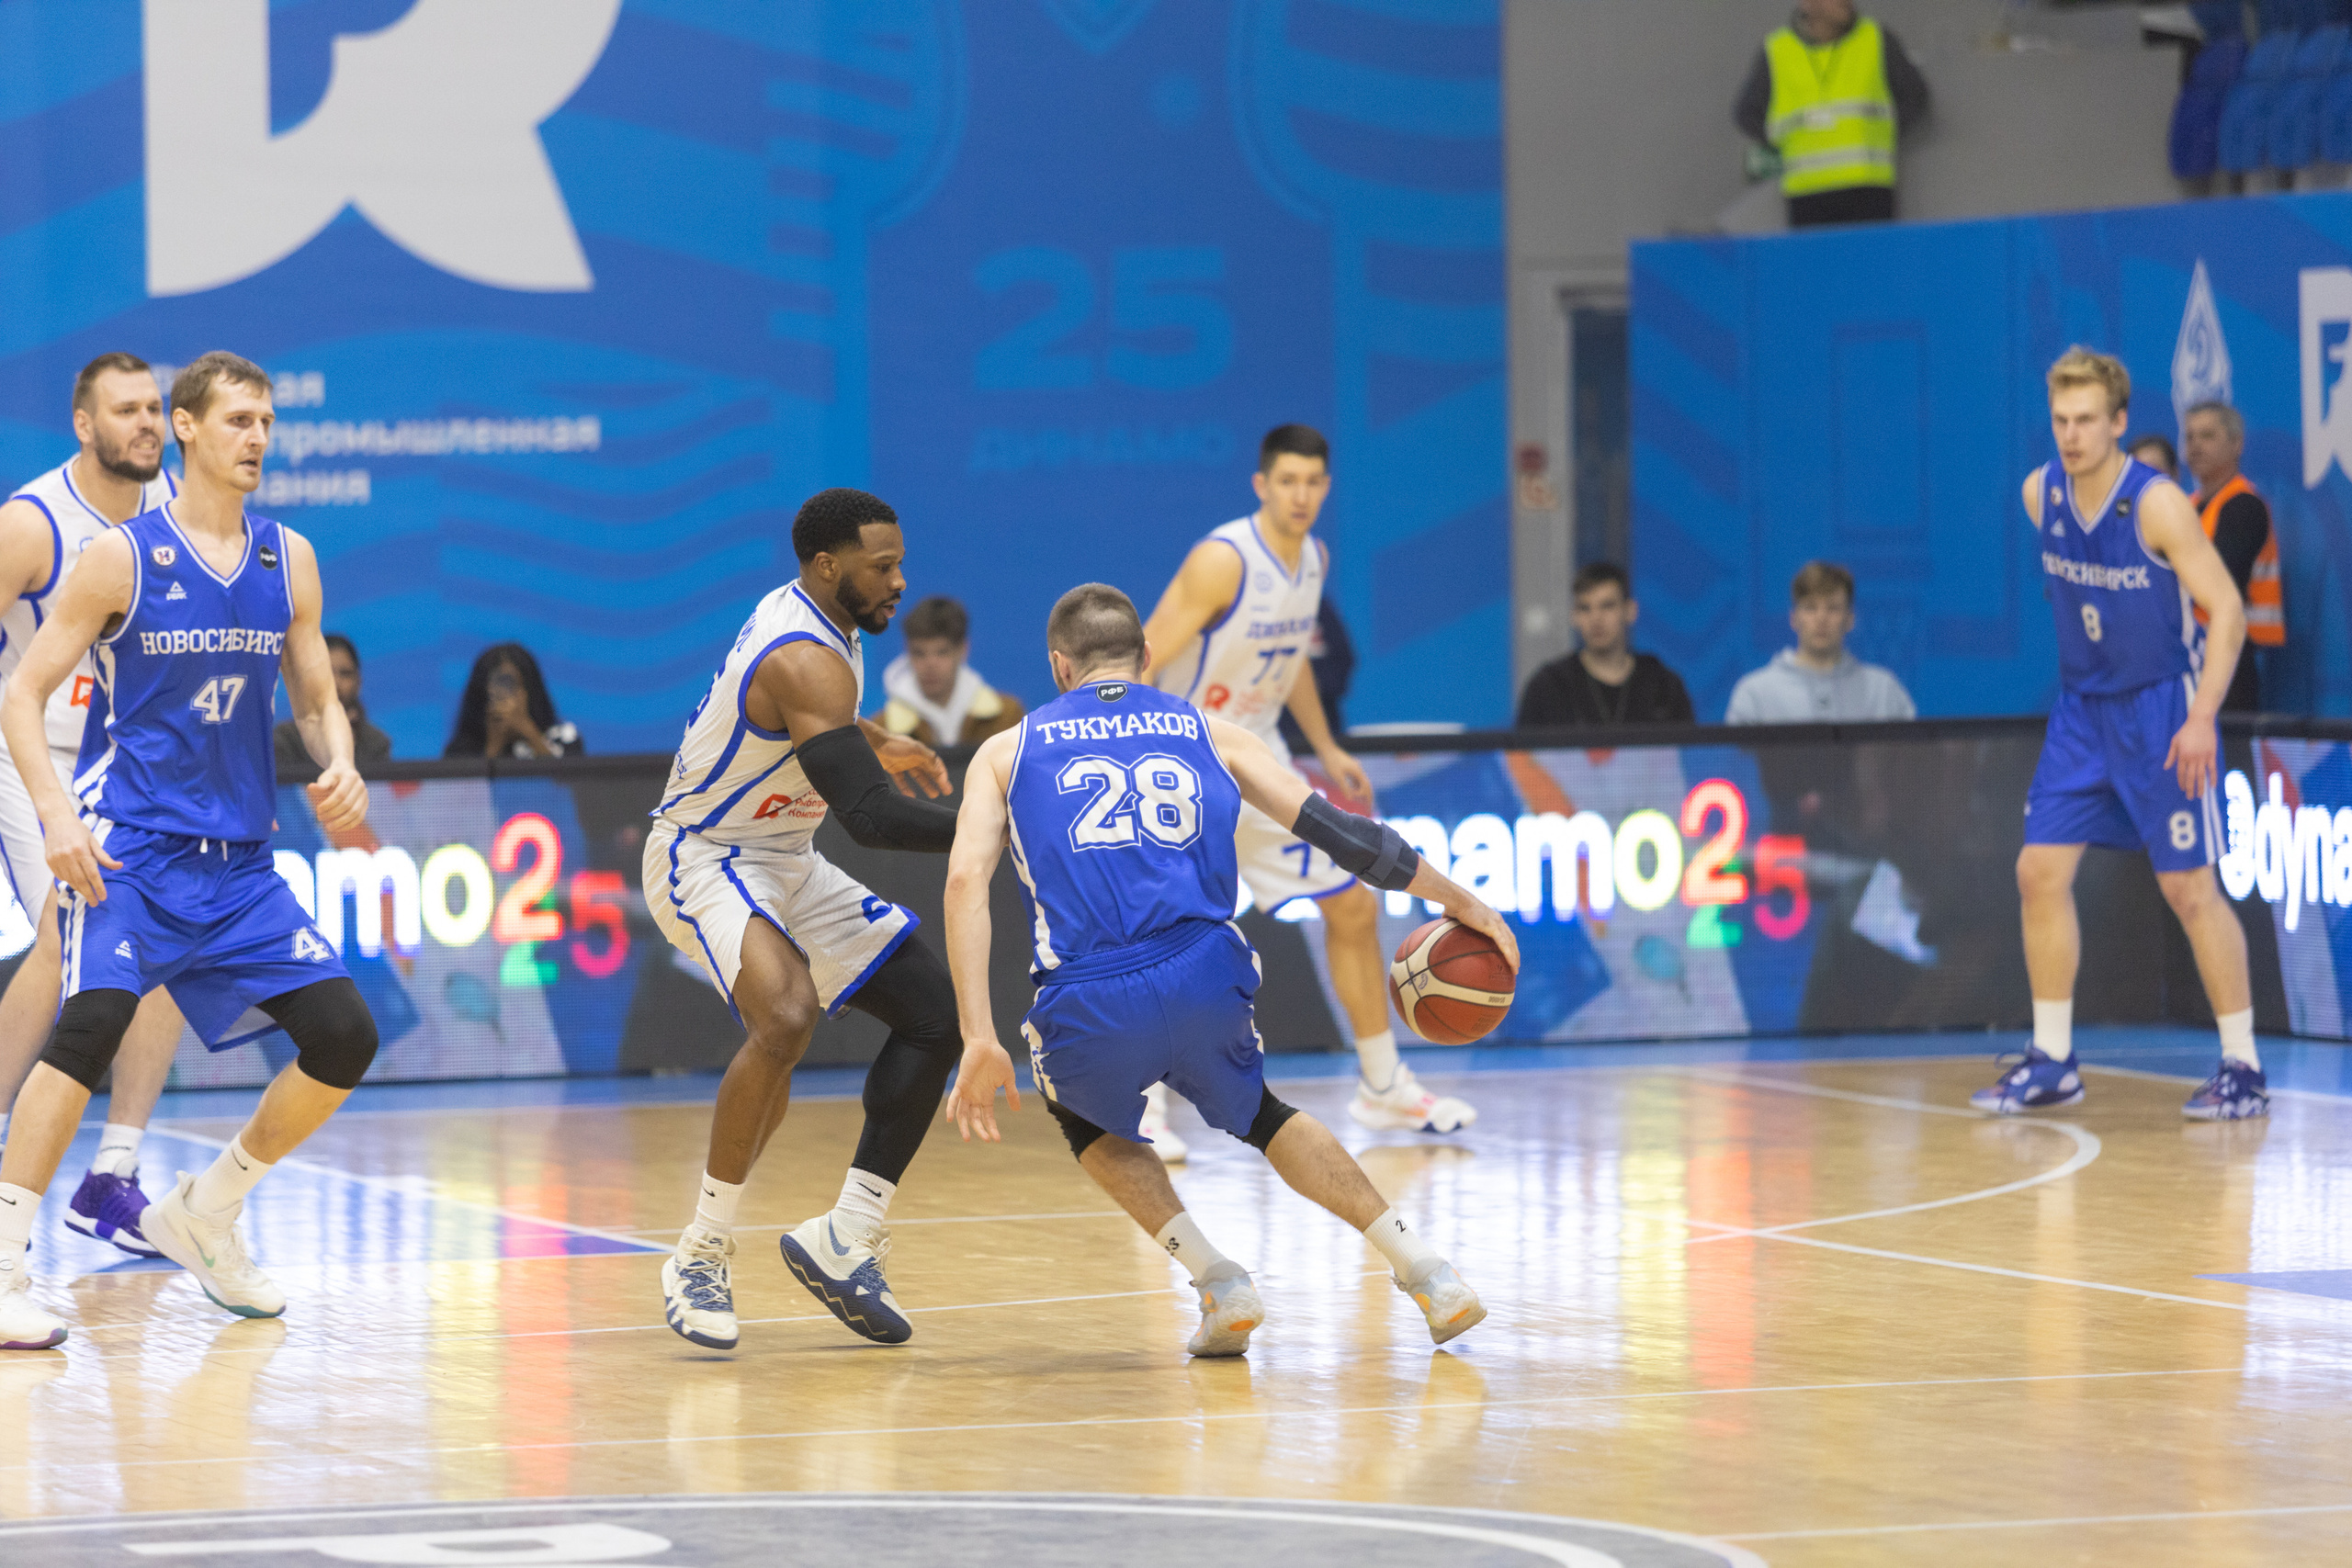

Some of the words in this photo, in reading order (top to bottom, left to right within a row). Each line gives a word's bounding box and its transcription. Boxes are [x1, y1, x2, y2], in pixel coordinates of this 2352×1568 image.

[972, 245, 1234, 391] 25
[268, 415, 601, 465] промышленная
[140, 628, 286, 655] НОВОСИБИРС
[2081, 604, 2102, 642] 8
[1251, 646, 1298, 685] 77
[189, 675, 248, 724] 47
[1101, 685, 1125, 696] РФБ
[1036, 712, 1198, 744] ТУКМАКОВ
[788, 808, 825, 818] Компани
[1056, 752, 1203, 852] 28
[2168, 810, 2197, 851] 8
[2255, 773, 2352, 933] dyna
[291, 925, 334, 963] 4
